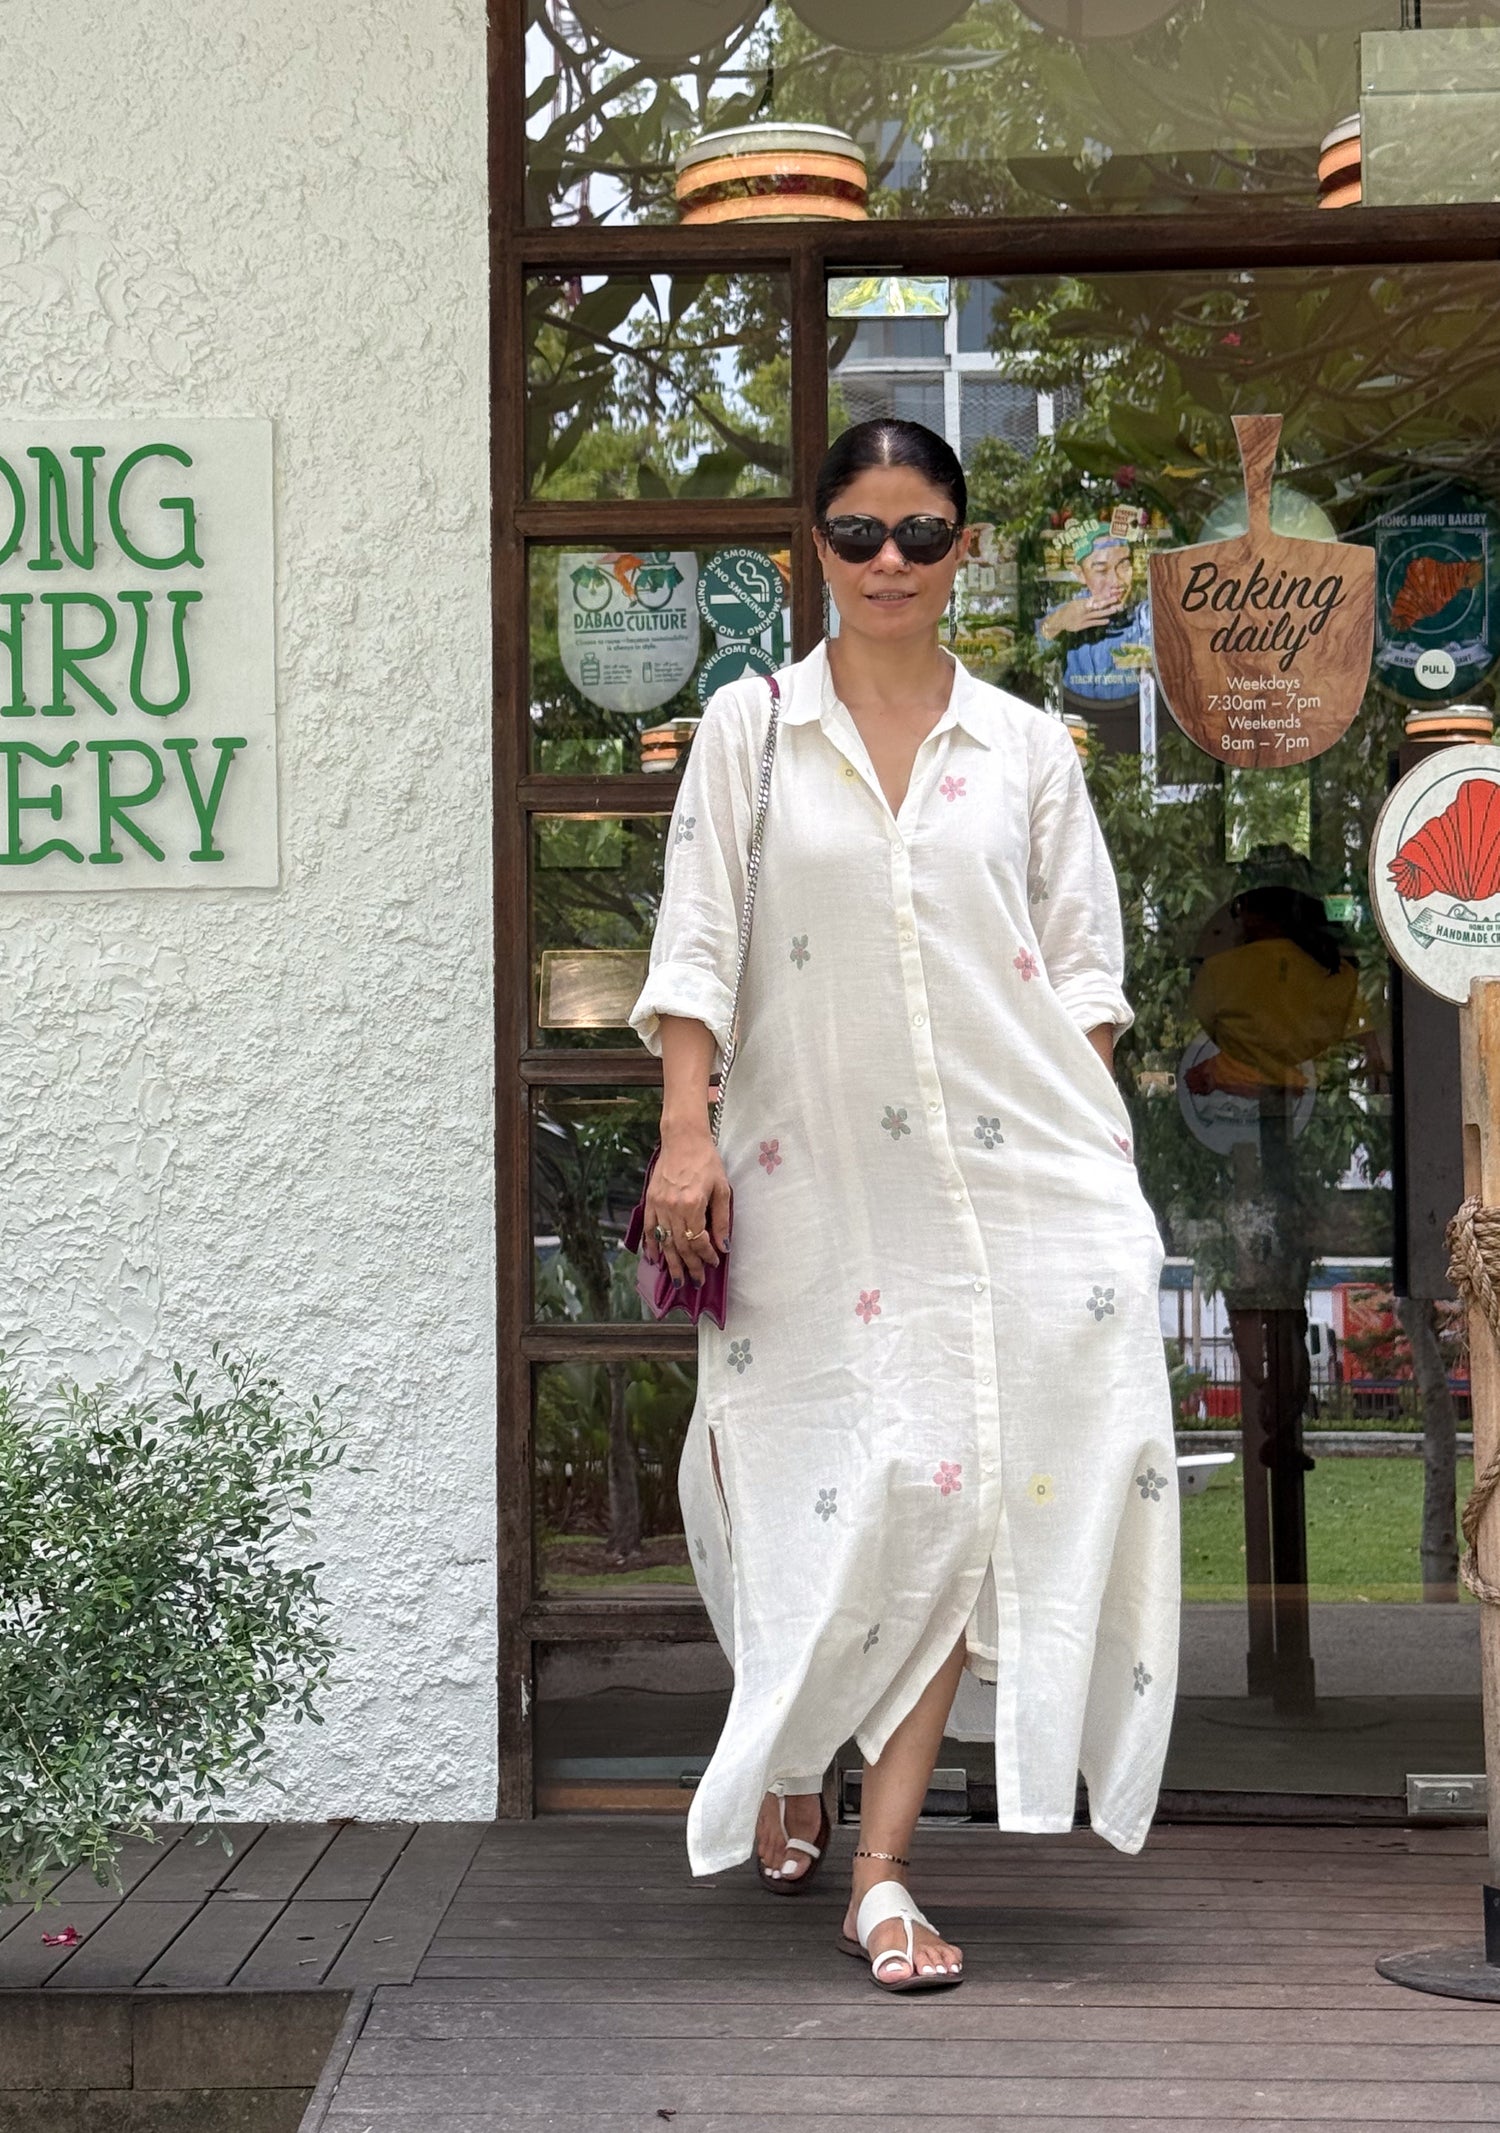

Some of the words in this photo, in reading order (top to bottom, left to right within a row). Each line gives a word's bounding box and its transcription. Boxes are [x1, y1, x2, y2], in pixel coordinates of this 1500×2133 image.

[0, 443, 204, 570] NG
[1410, 514, 1445, 527] BAHRU
[1448, 513, 1487, 526] BAKERY
[706, 556, 722, 571] NO
[723, 548, 771, 567] SMOKING
[714, 568, 729, 582] NO
[728, 581, 766, 618] SMOKING
[773, 576, 783, 594] NO
[697, 579, 719, 628] SMOKING
[1181, 557, 1347, 635] Baking
[574, 611, 624, 629] DABAO
[626, 613, 687, 632] CULTURE
[747, 597, 782, 636] SMOKING
[718, 625, 735, 636] NO
[1209, 611, 1310, 672] daily
[698, 672, 708, 694] PETS
[704, 645, 747, 671] WELCOME
[749, 647, 779, 673] OUTSID
[1422, 665, 1449, 674] PULL
[1226, 674, 1301, 693] Weekdays
[1207, 695, 1266, 711] 7:30am
[1285, 692, 1320, 713] 7pm
[1228, 713, 1301, 730] Weekends
[1221, 734, 1254, 750] 8am
[1274, 733, 1309, 752] 7pm
[1436, 925, 1488, 943] HANDMADE
